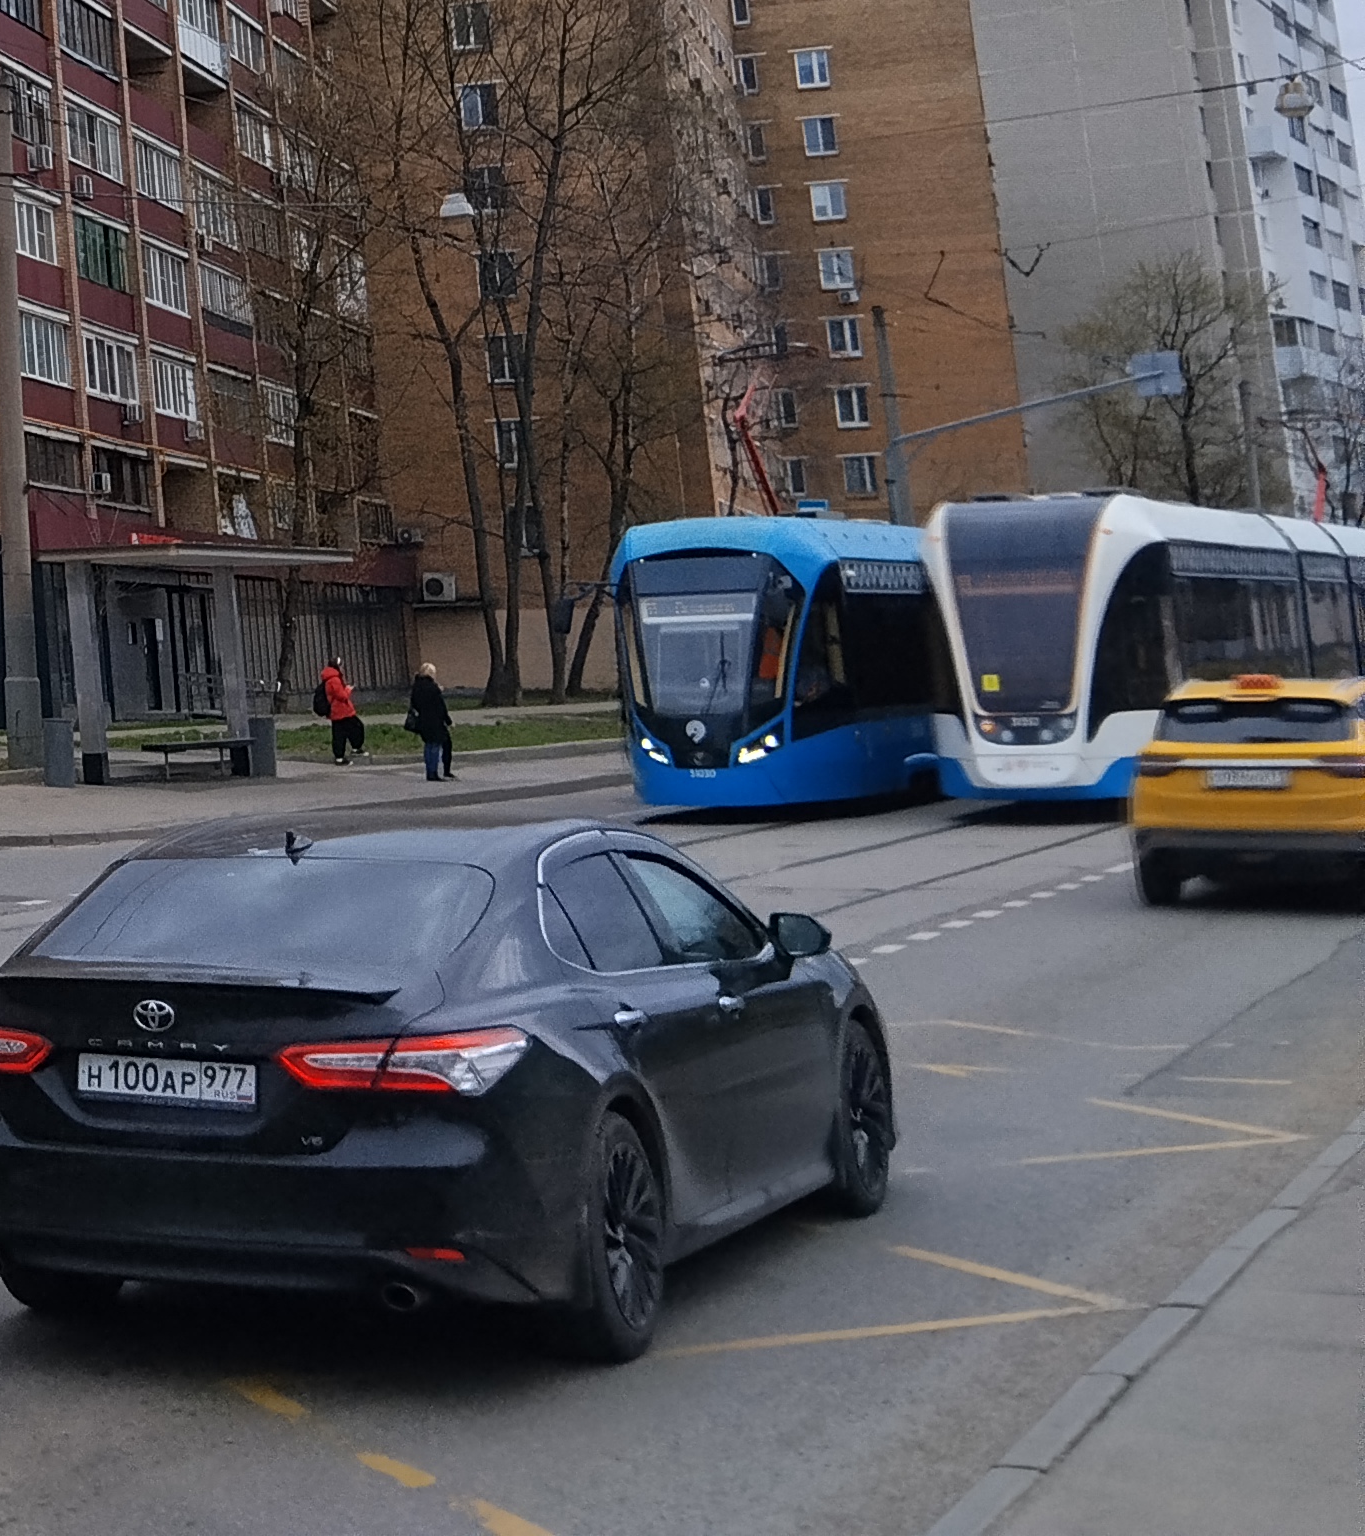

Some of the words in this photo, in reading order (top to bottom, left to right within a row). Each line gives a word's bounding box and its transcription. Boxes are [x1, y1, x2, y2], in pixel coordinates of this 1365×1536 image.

[87, 1037, 229, 1052] CAMRY
[87, 1059, 197, 1095] Н100АР
[203, 1064, 247, 1090] 977
[213, 1089, 237, 1100] RUS
